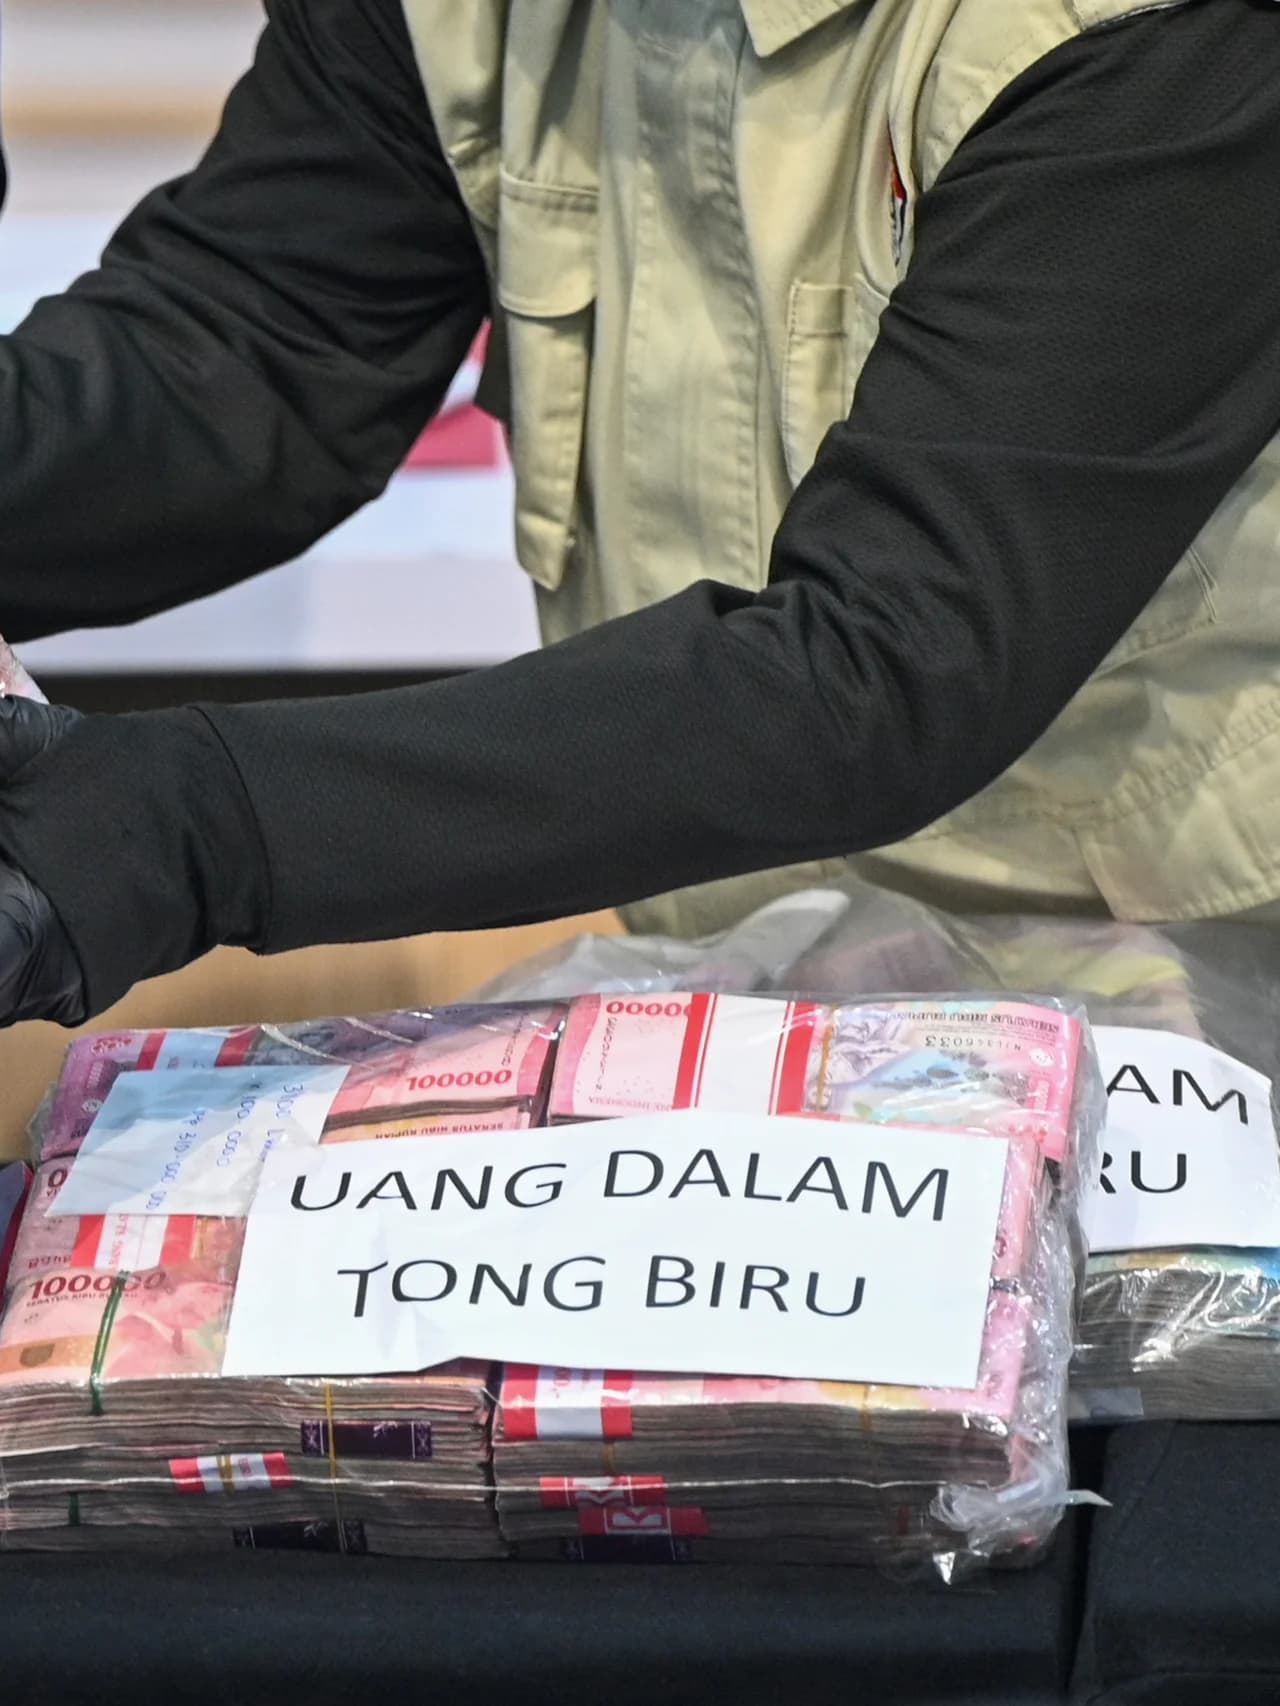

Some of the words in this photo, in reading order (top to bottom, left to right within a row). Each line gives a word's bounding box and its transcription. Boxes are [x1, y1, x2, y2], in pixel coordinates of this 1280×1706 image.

[406, 1069, 513, 1091] 100000
[290, 1162, 567, 1212] UANG
[603, 1148, 949, 1222] DALAM
[30, 1271, 167, 1301] 100000
[337, 1255, 606, 1319] TONG
[645, 1254, 866, 1317] BIRU
